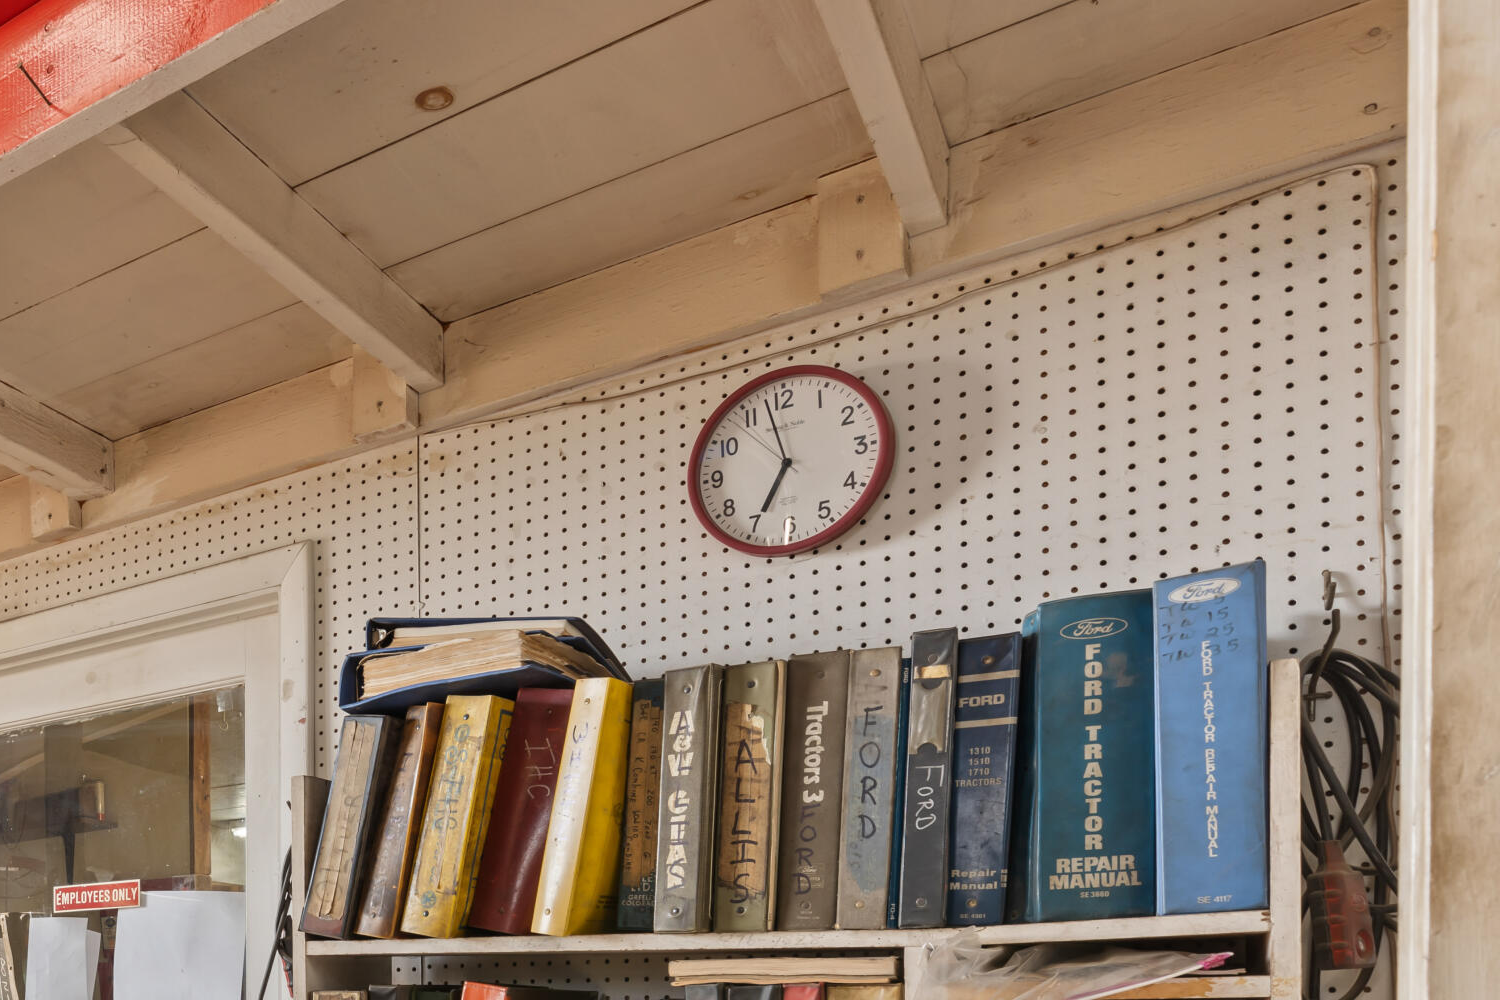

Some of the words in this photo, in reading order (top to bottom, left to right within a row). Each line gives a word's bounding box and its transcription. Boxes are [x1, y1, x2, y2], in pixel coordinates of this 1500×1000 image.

[774, 389, 795, 411] 12
[817, 389, 823, 409] 1
[745, 407, 757, 428] 11
[840, 405, 855, 427] 2
[720, 437, 739, 458] 10
[853, 434, 869, 455] 3
[711, 470, 724, 489] 9
[843, 471, 858, 490] 4
[722, 498, 736, 517] 8
[817, 500, 832, 520] 5
[748, 514, 763, 534] 7
[1182, 582, 1226, 600] Ford
[1073, 619, 1113, 637] Ford
[1201, 640, 1213, 676] FORD
[1083, 644, 1103, 716] FORD
[958, 693, 1005, 709] FORD
[1202, 682, 1215, 743] TRACTOR
[803, 700, 829, 785] Tractors
[969, 746, 991, 755] 1310
[515, 737, 556, 799] IHC
[968, 757, 990, 766] 1510
[859, 705, 883, 839] FORD
[968, 768, 990, 777] 1710
[1205, 749, 1218, 801] REPAIR
[955, 777, 1002, 788] TRACTORS
[1083, 726, 1103, 851] TRACTOR
[803, 789, 824, 804] 3
[915, 764, 944, 830] FORD
[730, 739, 758, 903] ALLIS
[1205, 806, 1219, 858] MANUAL
[793, 803, 821, 895] FORD
[951, 869, 997, 880] Repair
[1056, 855, 1136, 874] REPAIR
[950, 881, 998, 891] Manual
[1050, 871, 1142, 890] MANUAL
[56, 888, 111, 907] EMPLOYEES
[112, 887, 138, 902] ONLY
[1197, 896, 1210, 904] SE
